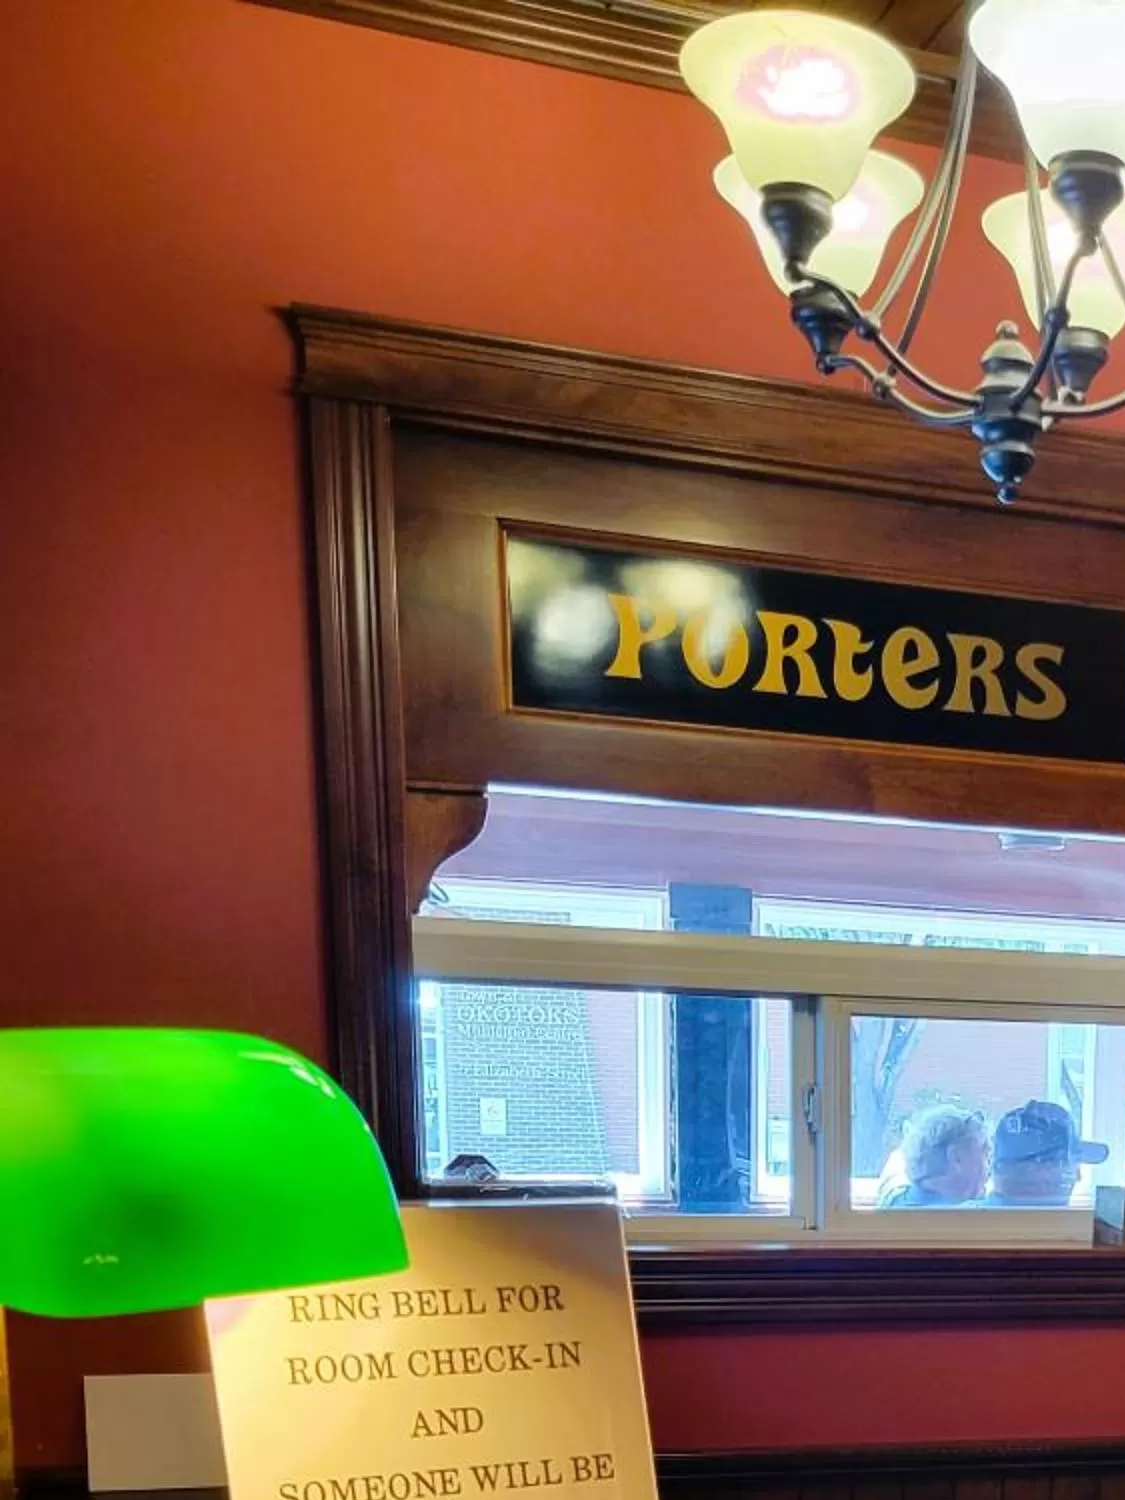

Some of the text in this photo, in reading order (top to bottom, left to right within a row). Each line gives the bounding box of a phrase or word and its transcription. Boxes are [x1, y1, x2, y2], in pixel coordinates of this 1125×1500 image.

[458, 1004, 578, 1025] OKOTOKS
[287, 1284, 565, 1322] RING BELL FOR
[285, 1341, 583, 1385] ROOM CHECK-IN
[410, 1407, 484, 1438] AND
[469, 1458, 563, 1492] WILL
[571, 1453, 616, 1482] BE
